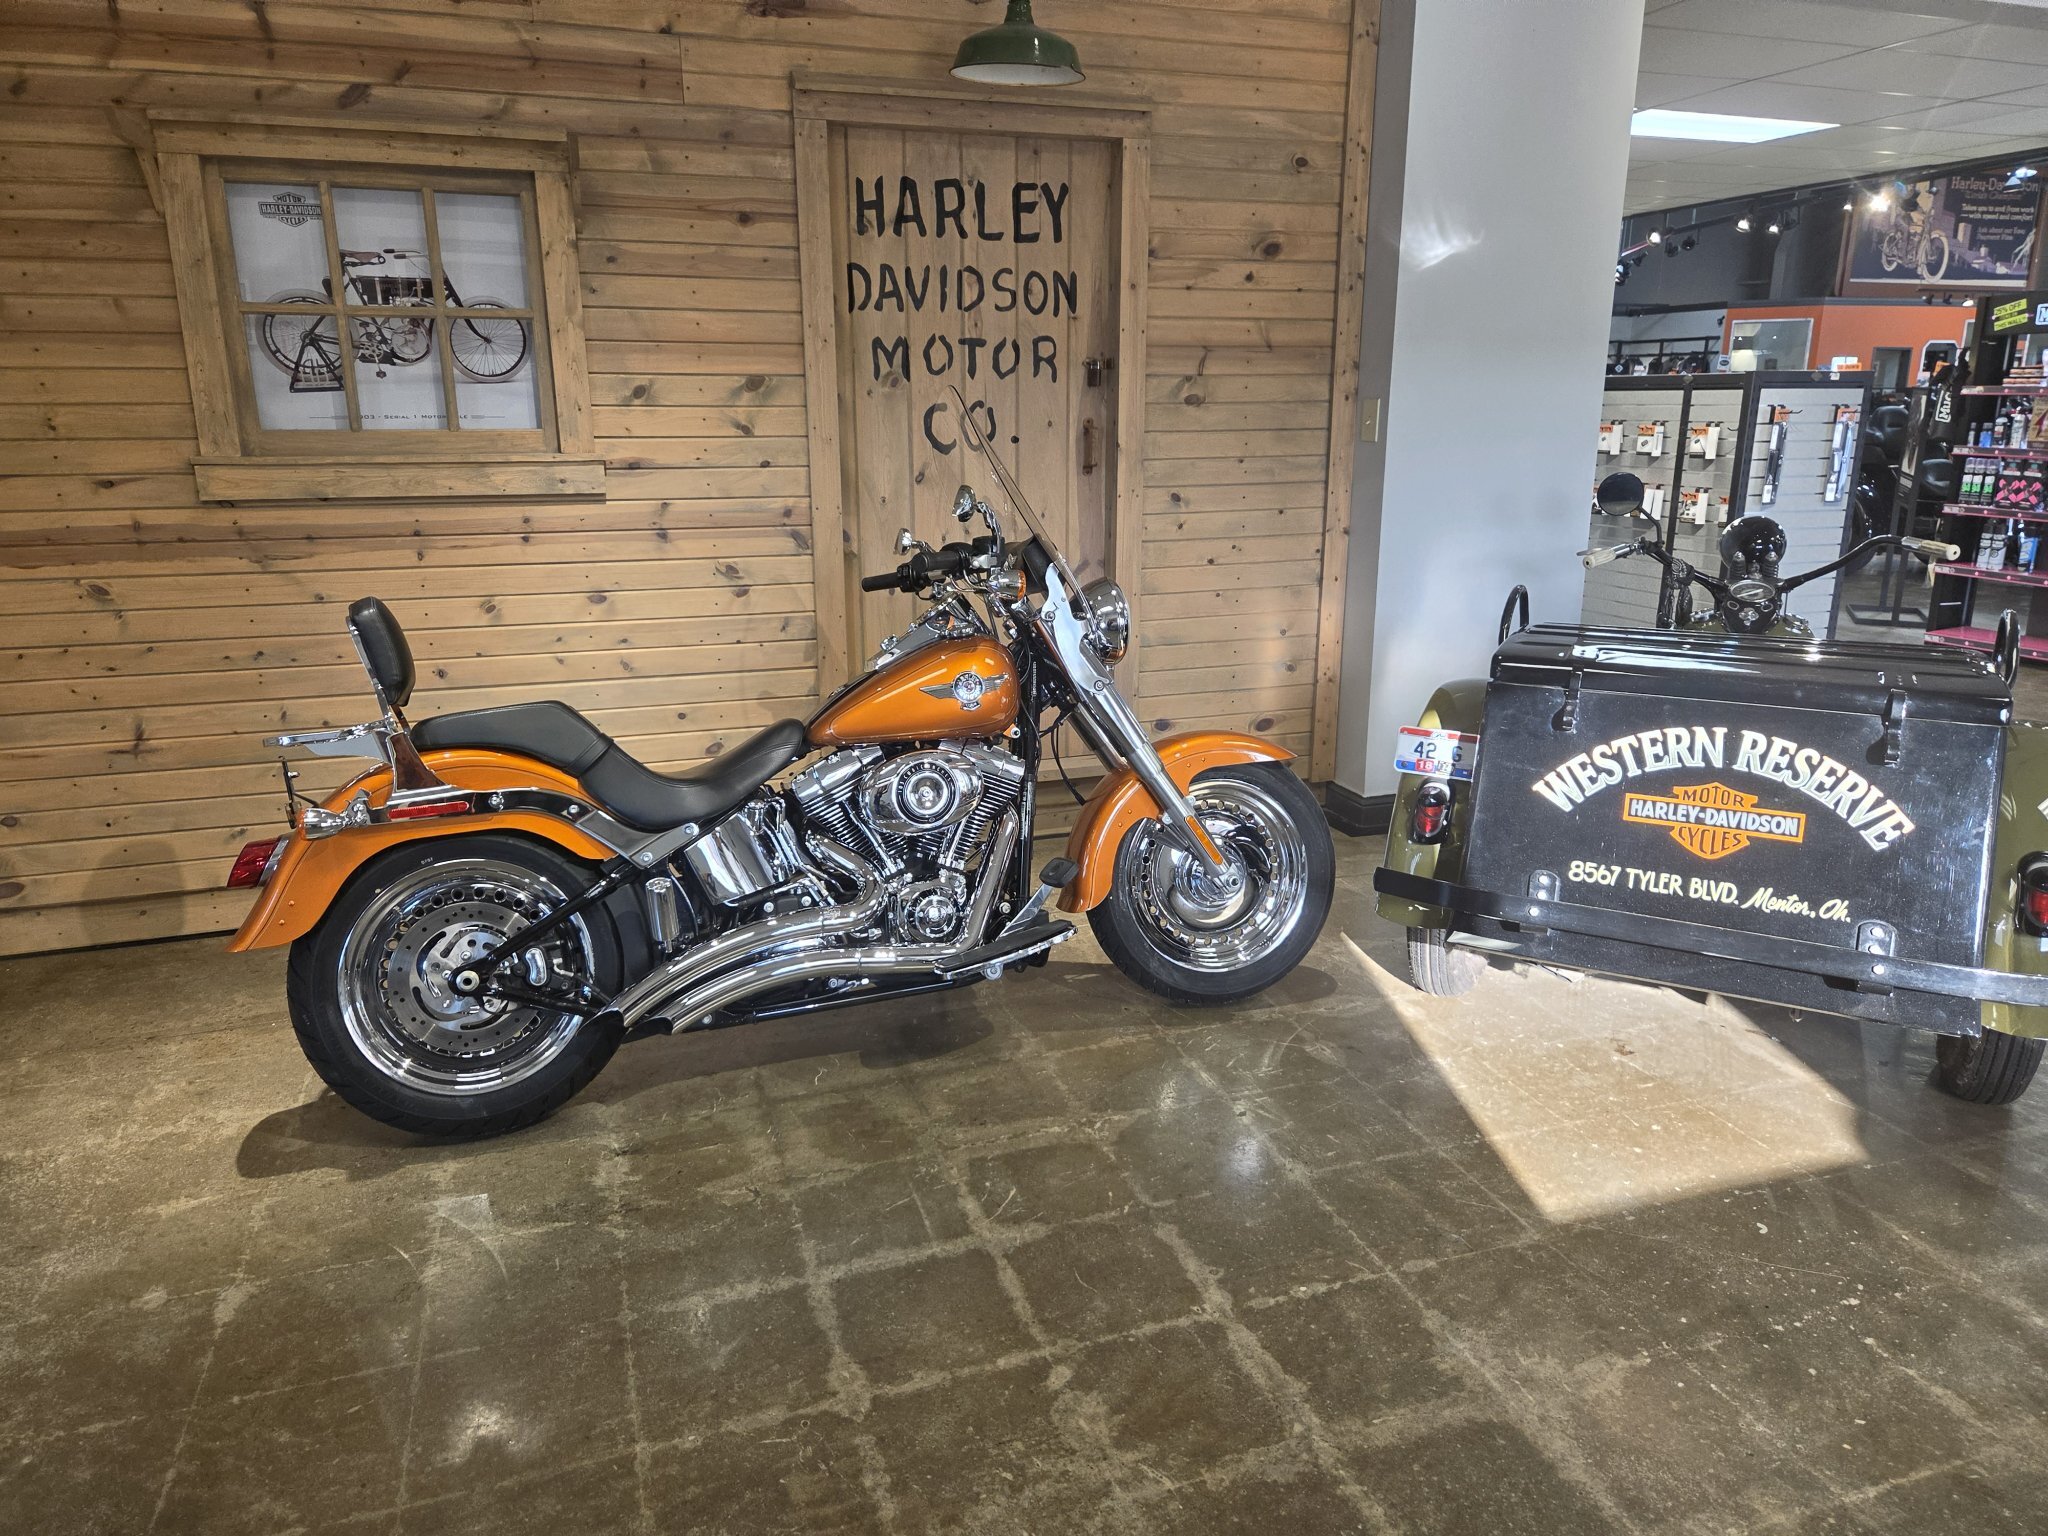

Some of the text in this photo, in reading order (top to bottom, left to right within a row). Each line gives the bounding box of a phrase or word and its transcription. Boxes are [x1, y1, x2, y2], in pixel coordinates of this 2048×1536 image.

[276, 194, 302, 202] MOTOR
[1951, 176, 2039, 192] Harley-Dason
[261, 204, 321, 215] HARLEY-DAVIDSON
[855, 176, 1069, 243] HARLEY
[847, 263, 1077, 318] DAVIDSON
[871, 333, 1058, 383] MOTOR
[923, 400, 1020, 455] CO.
[1532, 726, 1916, 851] WESTERN RESERVE
[1682, 786, 1745, 808] MOTOR
[1631, 799, 1799, 836] HARLEY-DAVIDSON
[1678, 826, 1742, 855] CYCLES
[1568, 860, 1620, 886] 8567
[1625, 868, 1684, 897] TYLER
[1689, 877, 1739, 905] BLVD.
[1818, 898, 1851, 923] Oh.
